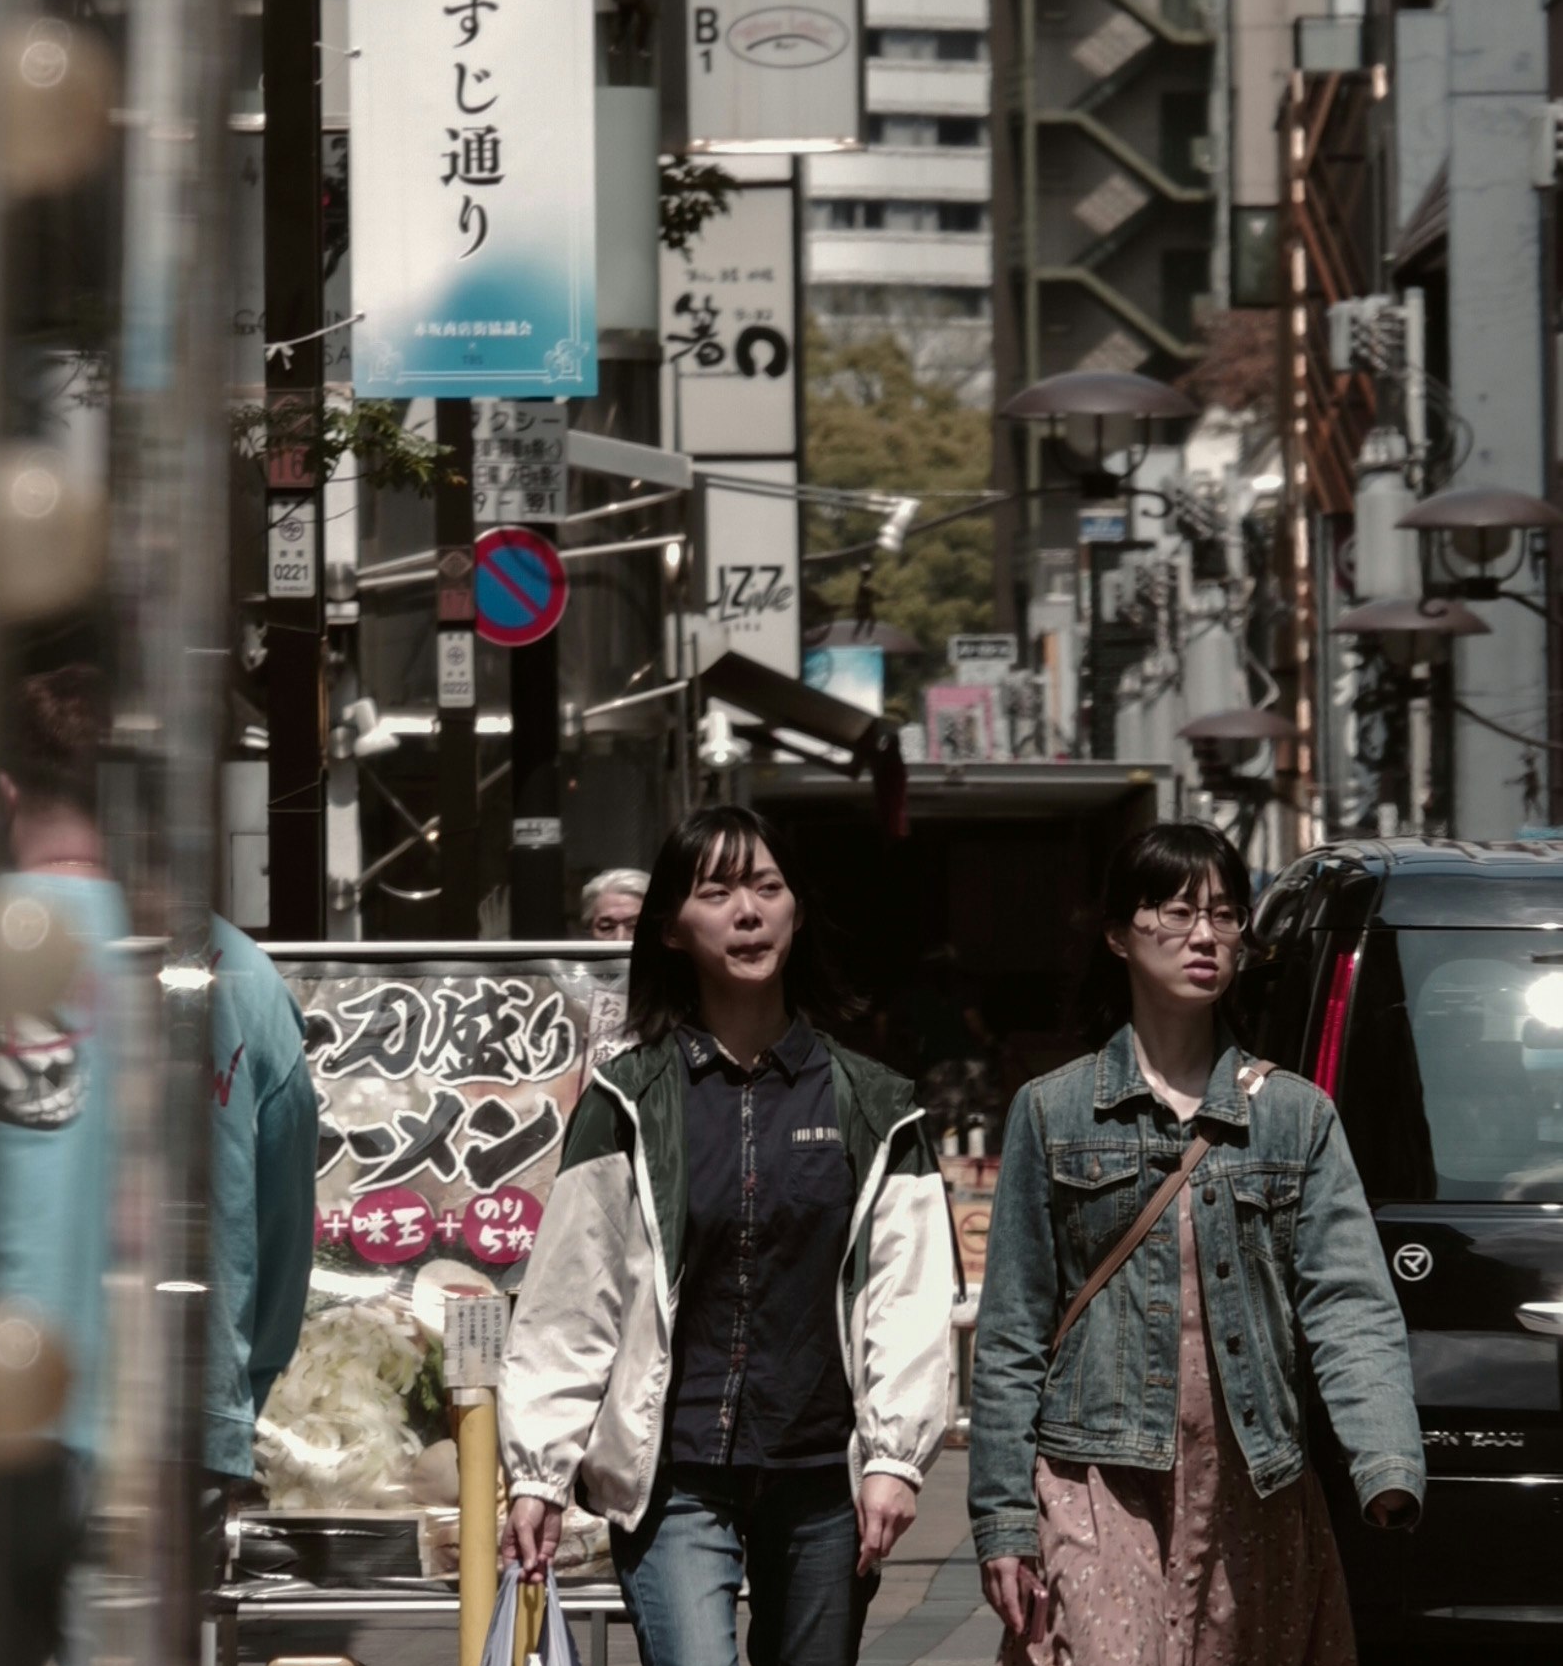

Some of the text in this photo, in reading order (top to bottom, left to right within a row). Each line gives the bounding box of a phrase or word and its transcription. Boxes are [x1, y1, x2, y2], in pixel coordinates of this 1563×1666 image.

[274, 564, 309, 581] 0221
[315, 1086, 564, 1193] ーメン
[475, 1197, 524, 1219] のり
[352, 1207, 427, 1247] 味玉
[1464, 1431, 1525, 1447] TAXI
